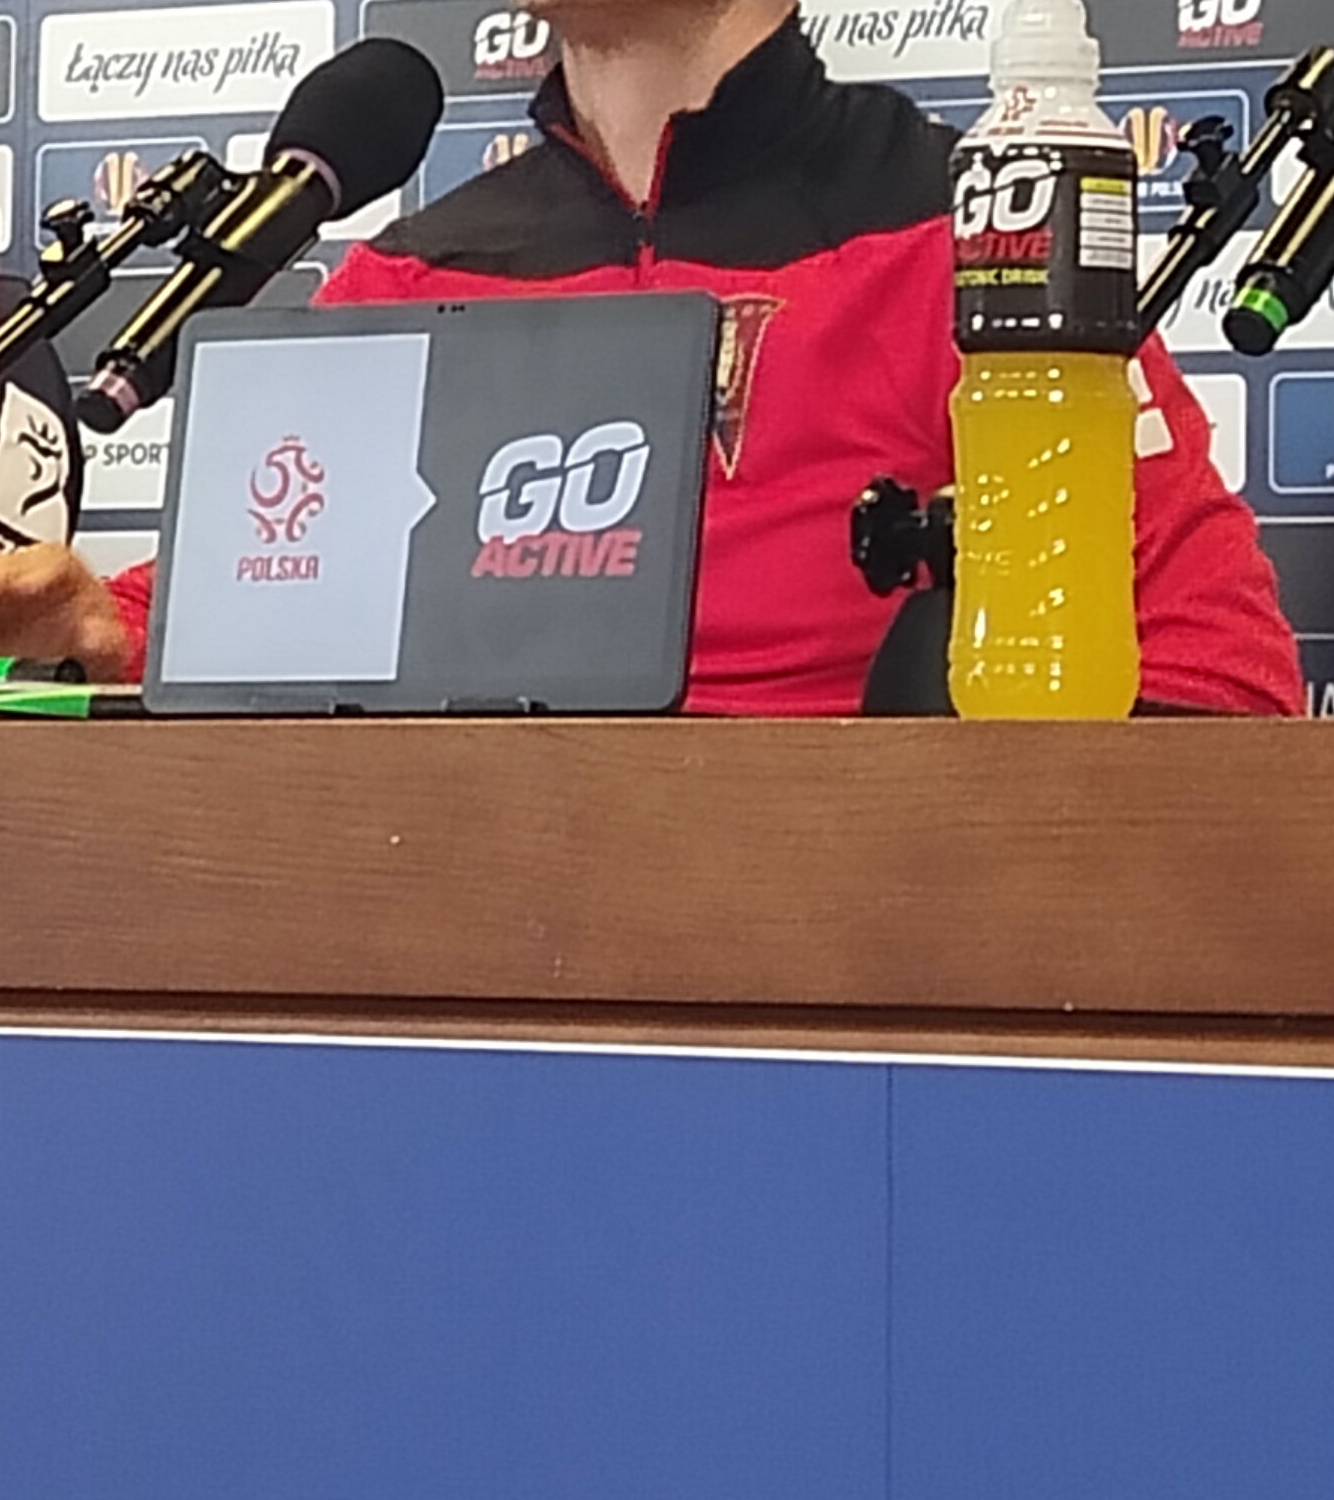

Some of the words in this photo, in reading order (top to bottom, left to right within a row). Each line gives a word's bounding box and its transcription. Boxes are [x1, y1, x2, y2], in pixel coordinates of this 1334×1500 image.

[835, 10, 898, 46] nas
[65, 43, 158, 97] Łączy
[161, 48, 219, 82] nas
[213, 31, 301, 92] piłka
[954, 159, 1056, 239] GO
[477, 422, 650, 544] GO
[236, 556, 318, 582] POLSKA
[471, 529, 642, 578] ACTIVE
